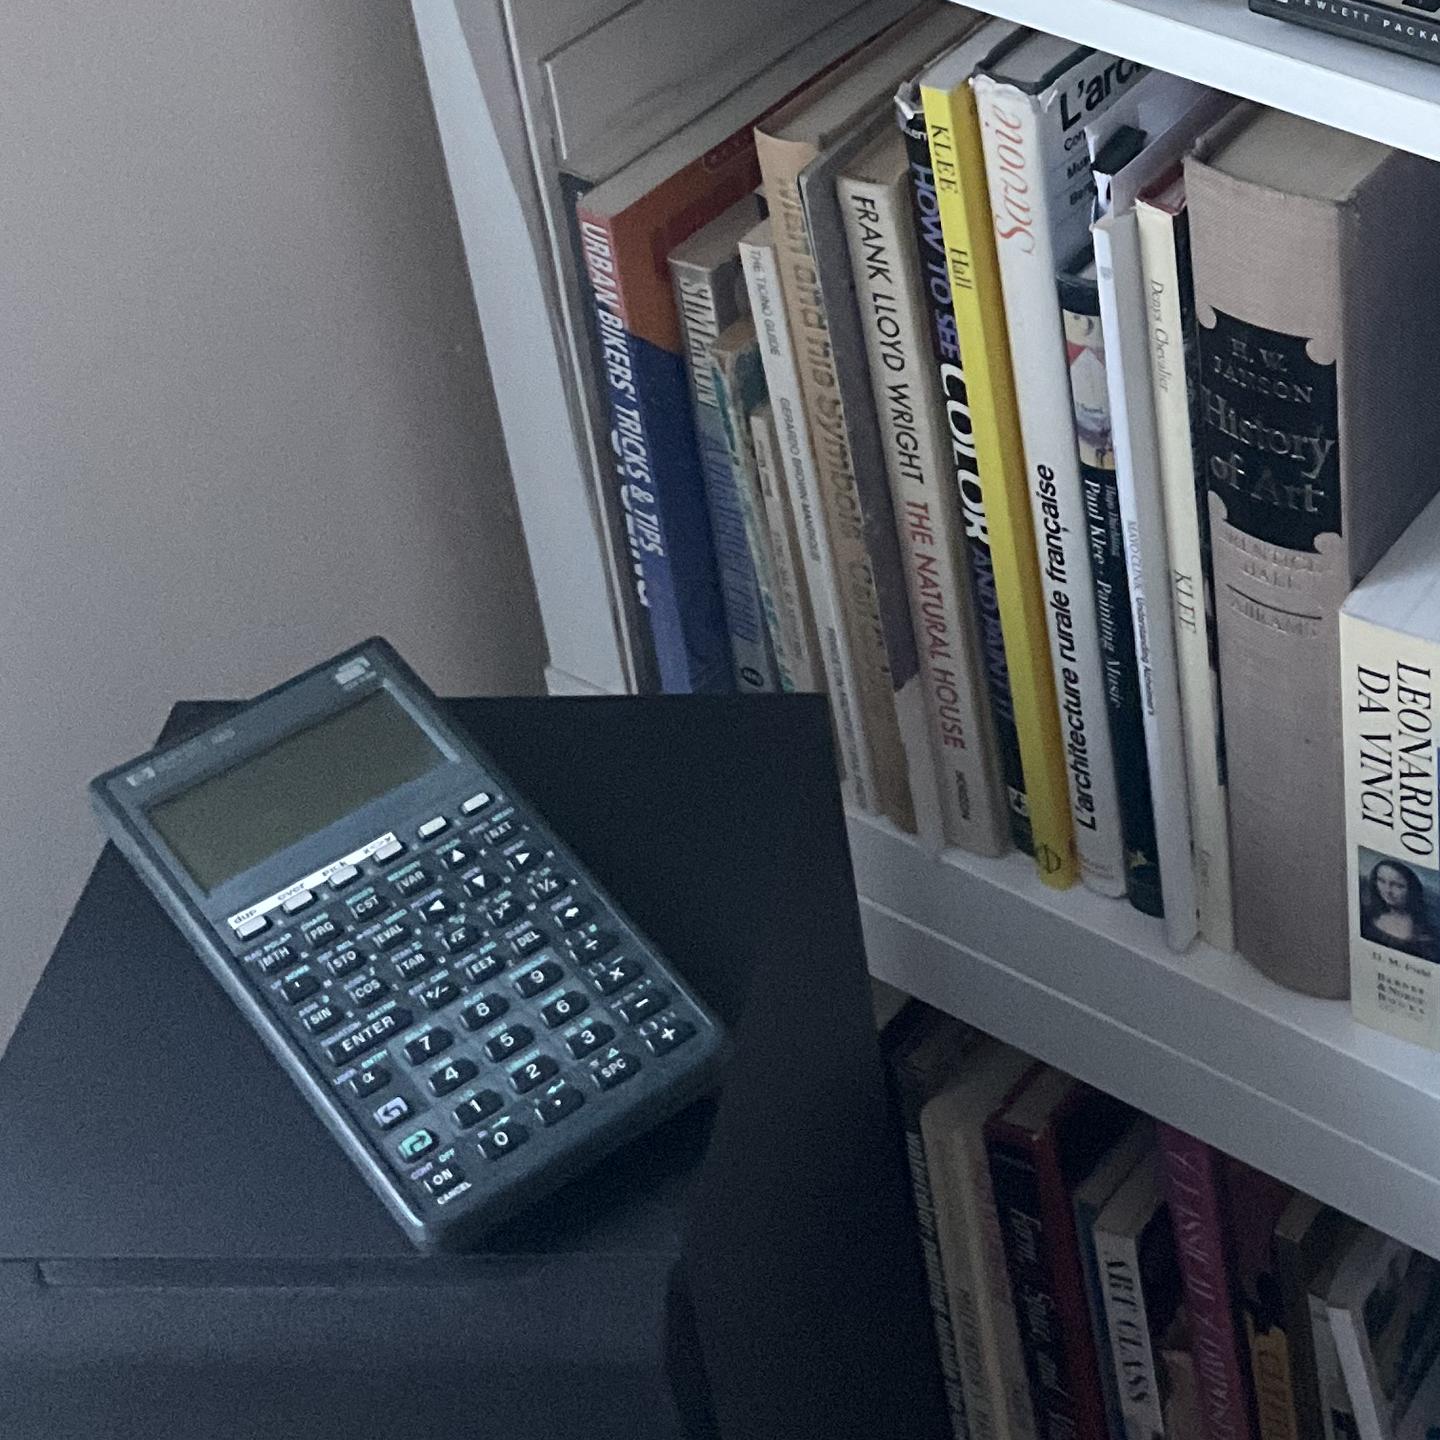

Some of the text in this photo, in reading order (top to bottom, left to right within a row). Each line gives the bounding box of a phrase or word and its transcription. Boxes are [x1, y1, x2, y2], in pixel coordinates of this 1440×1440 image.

[985, 103, 1036, 255] Savoie
[911, 162, 946, 258] HOW
[930, 123, 973, 291] KLEE Hall
[582, 221, 620, 310] URBAN
[927, 259, 951, 306] TO
[598, 308, 638, 403] BIKERS'
[935, 307, 960, 360] SEE
[615, 403, 652, 483] TRICKS
[940, 362, 992, 547] COLOR
[1200, 383, 1336, 480] History
[630, 482, 655, 504] &
[851, 194, 966, 751] FRANK LLOYD WRIGHT THE NATURAL HOUSE
[1210, 452, 1325, 512] of Art
[1085, 478, 1105, 522] Paul
[634, 508, 666, 558] TIPS
[1090, 523, 1108, 568] Klee
[1096, 579, 1118, 653] Painting
[1135, 596, 1150, 664] Understanding
[1036, 462, 1097, 831] L'architecture rurale française
[1357, 664, 1395, 831] DA VINCI
[1397, 660, 1434, 857] LEONARDO
[398, 867, 426, 886] VAR
[233, 906, 260, 924] dup
[354, 893, 381, 913] CST
[263, 943, 291, 964] MTH
[308, 919, 336, 938] PRG
[354, 975, 382, 995] COS
[400, 951, 427, 970] TAN
[308, 1004, 333, 1023] SIN
[340, 1011, 397, 1050] ENTER
[600, 1055, 628, 1075] SPC
[431, 1165, 454, 1184] ON
[436, 1178, 472, 1202] CANCEL
